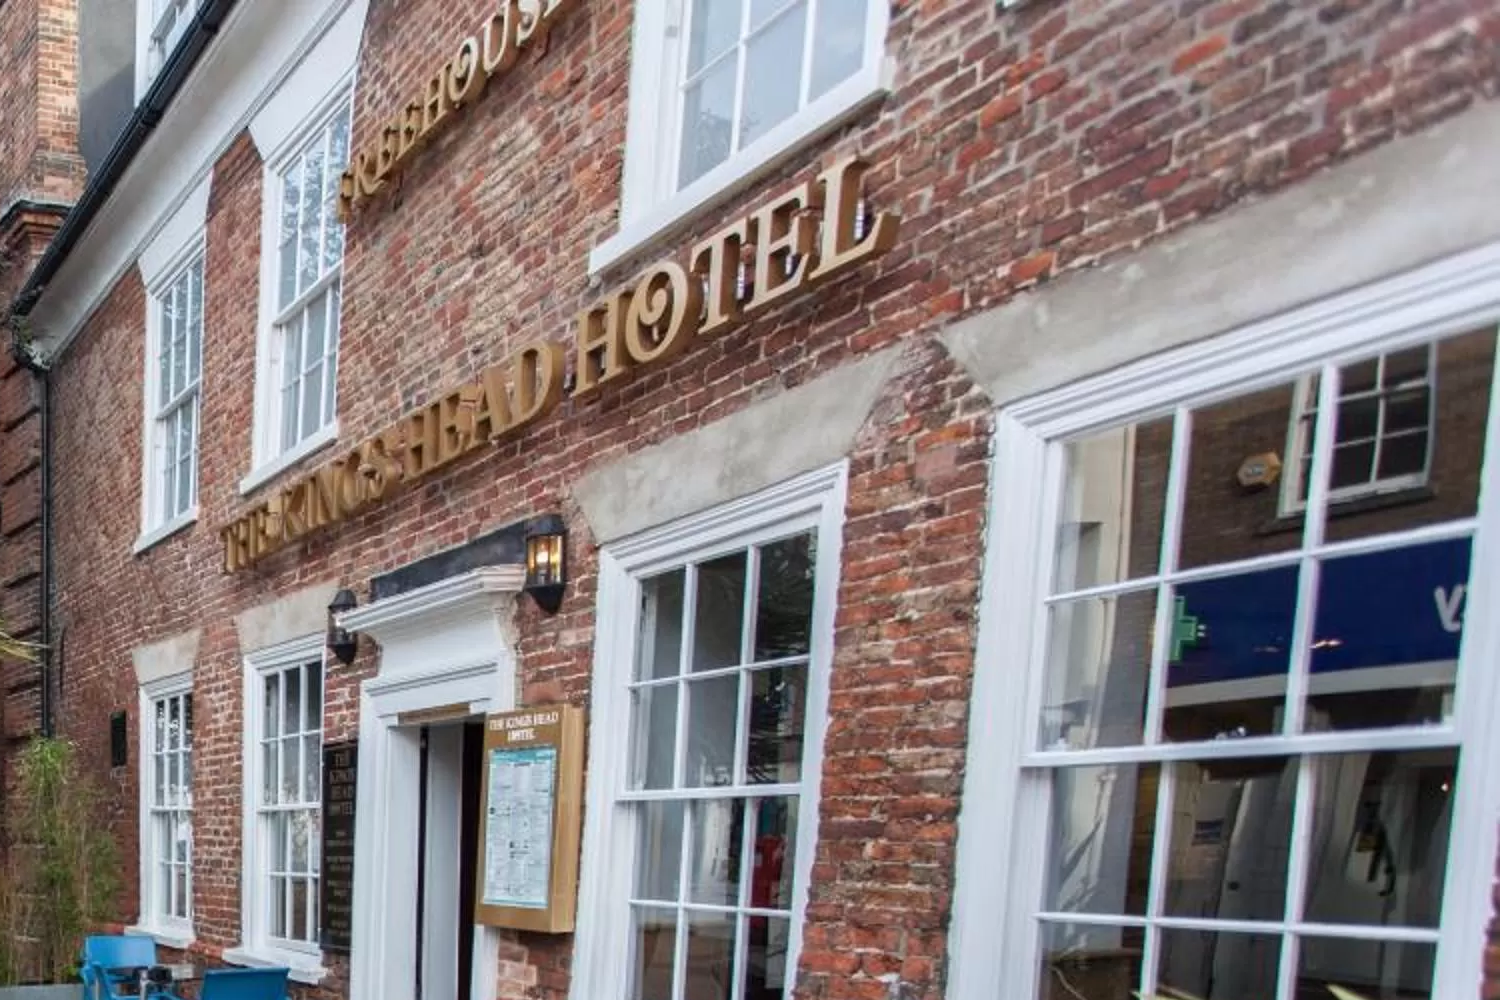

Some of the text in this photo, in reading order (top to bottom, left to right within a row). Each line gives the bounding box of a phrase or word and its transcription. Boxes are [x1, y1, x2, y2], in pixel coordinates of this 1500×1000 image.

[334, 0, 568, 224] FREEHOUS
[219, 500, 284, 575] THE
[401, 339, 567, 484] HEAD
[568, 153, 901, 398] HOTEL
